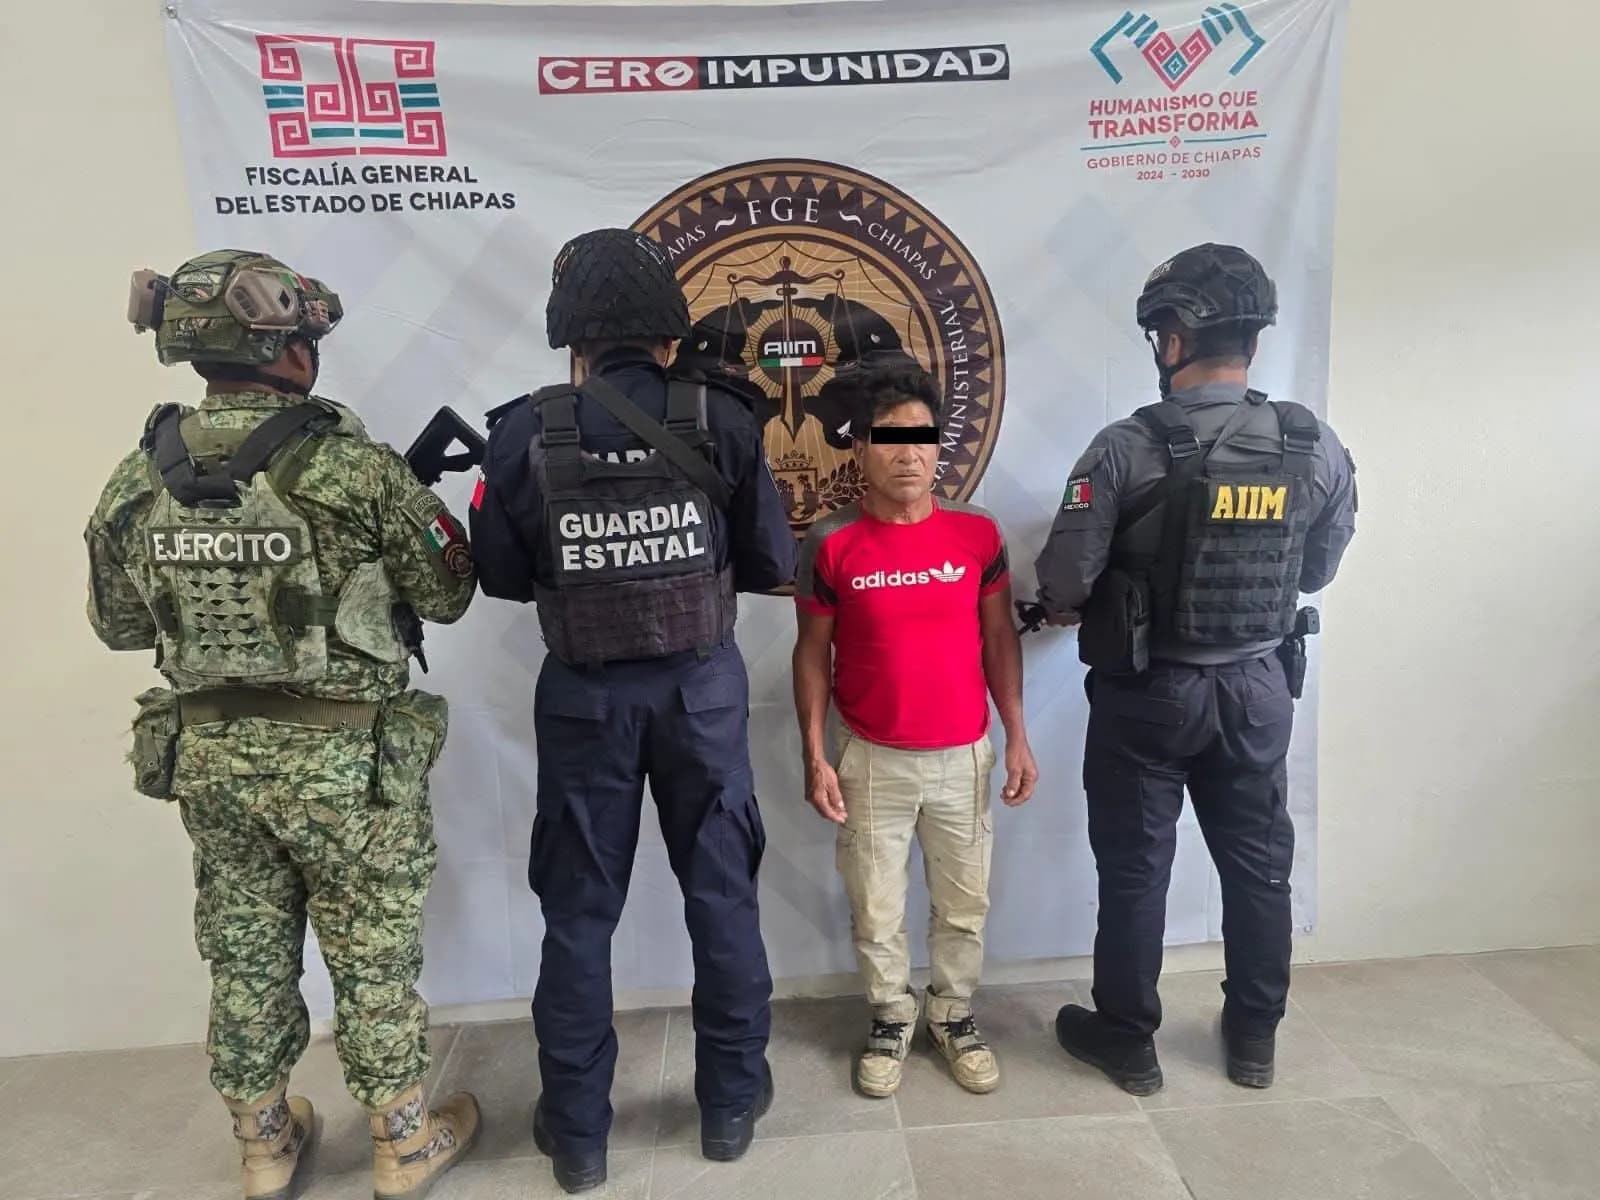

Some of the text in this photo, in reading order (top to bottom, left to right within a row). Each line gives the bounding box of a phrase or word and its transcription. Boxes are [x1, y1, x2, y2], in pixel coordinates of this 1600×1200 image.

[707, 48, 1007, 85] IMPUNIDAD
[1089, 91, 1258, 116] HUMANISMO QUE
[1088, 110, 1259, 139] TRANSFORMA
[1087, 147, 1261, 169] GOBIERNO DE CHIAPAS
[245, 162, 477, 186] FISCALÍA GENERAL
[1136, 170, 1163, 180] 2024
[1182, 169, 1210, 179] 2030
[215, 191, 516, 214] DEL ESTADO DE CHIAPAS
[747, 196, 820, 225] FGE
[667, 224, 706, 260] APAS
[867, 222, 937, 281] CHIAPAS
[940, 300, 969, 452] MINISTERIAL
[1211, 485, 1287, 520] AIIM
[560, 501, 702, 539] GUARDIA
[153, 529, 292, 562] EJÉRCITO
[562, 532, 705, 570] ESTATAL
[852, 569, 930, 590] adidas
